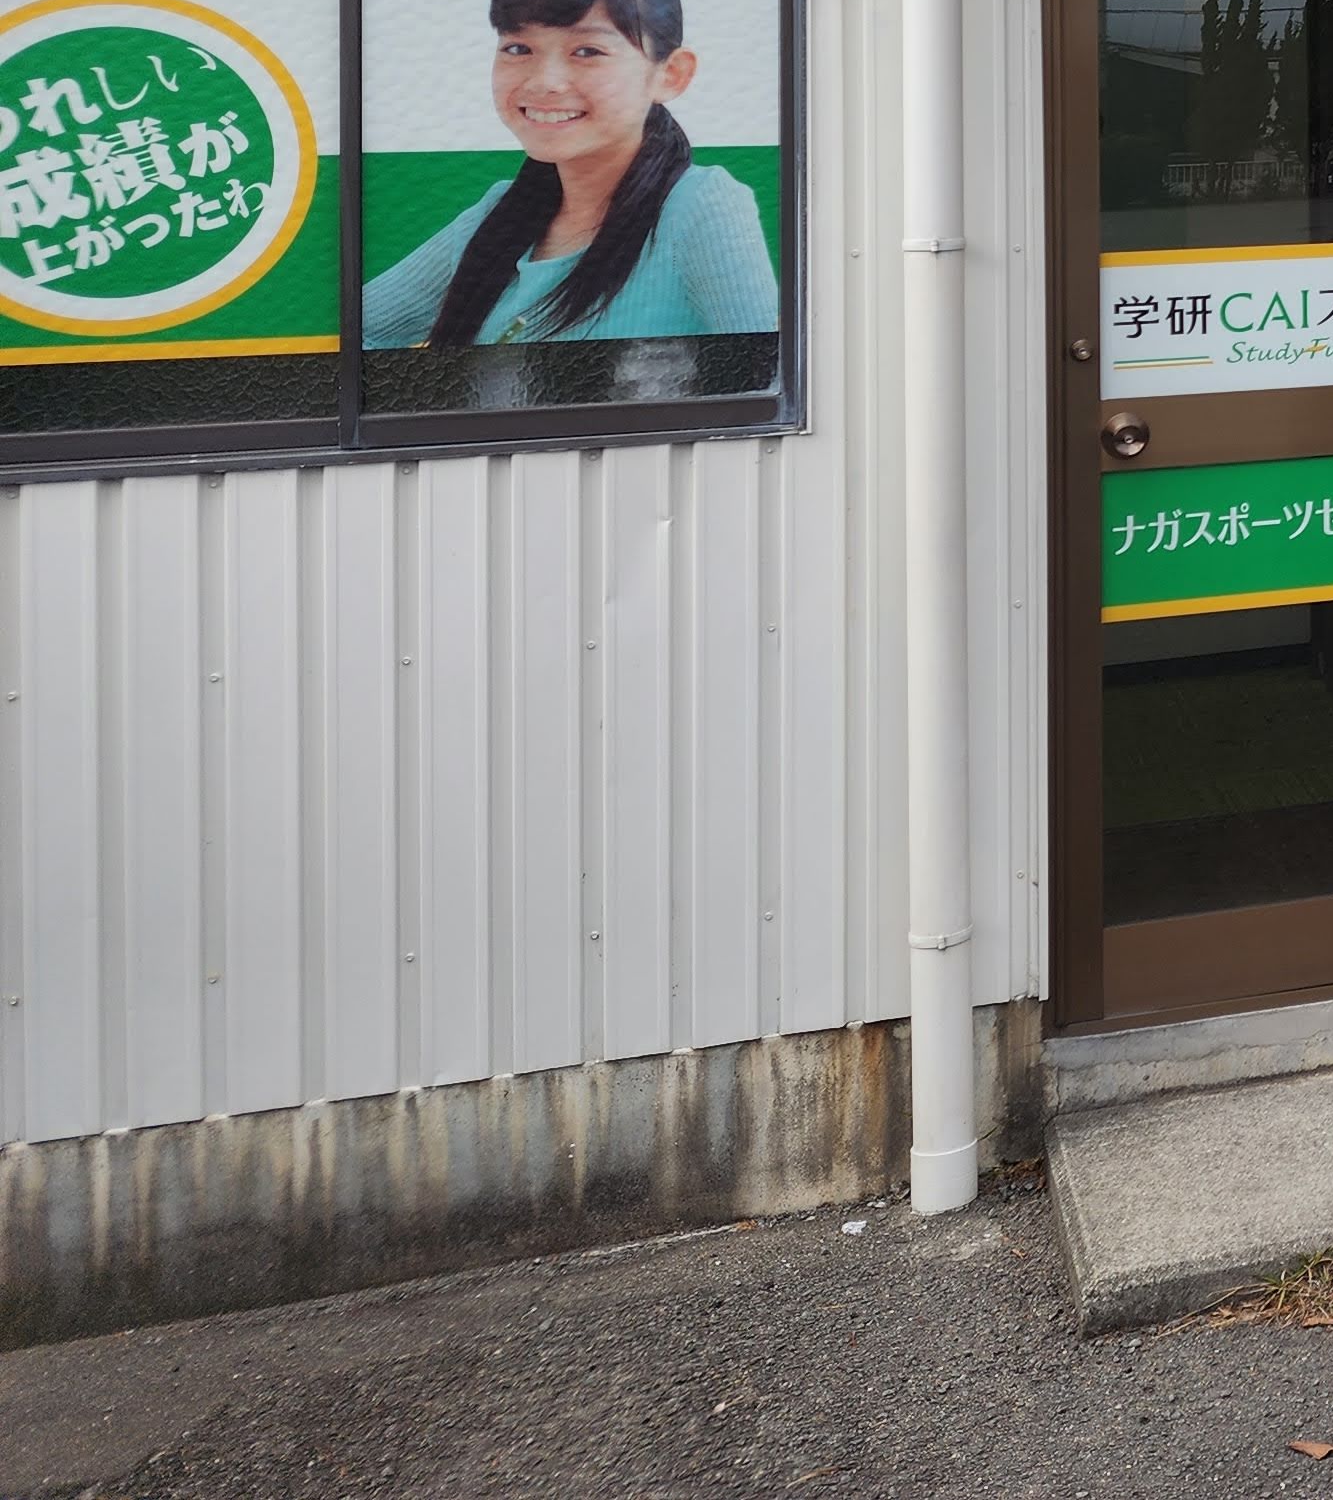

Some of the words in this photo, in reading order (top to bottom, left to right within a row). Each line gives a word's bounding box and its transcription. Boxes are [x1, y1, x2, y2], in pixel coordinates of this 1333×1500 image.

[0, 110, 249, 239] 成績が
[22, 179, 272, 286] 上がったわ
